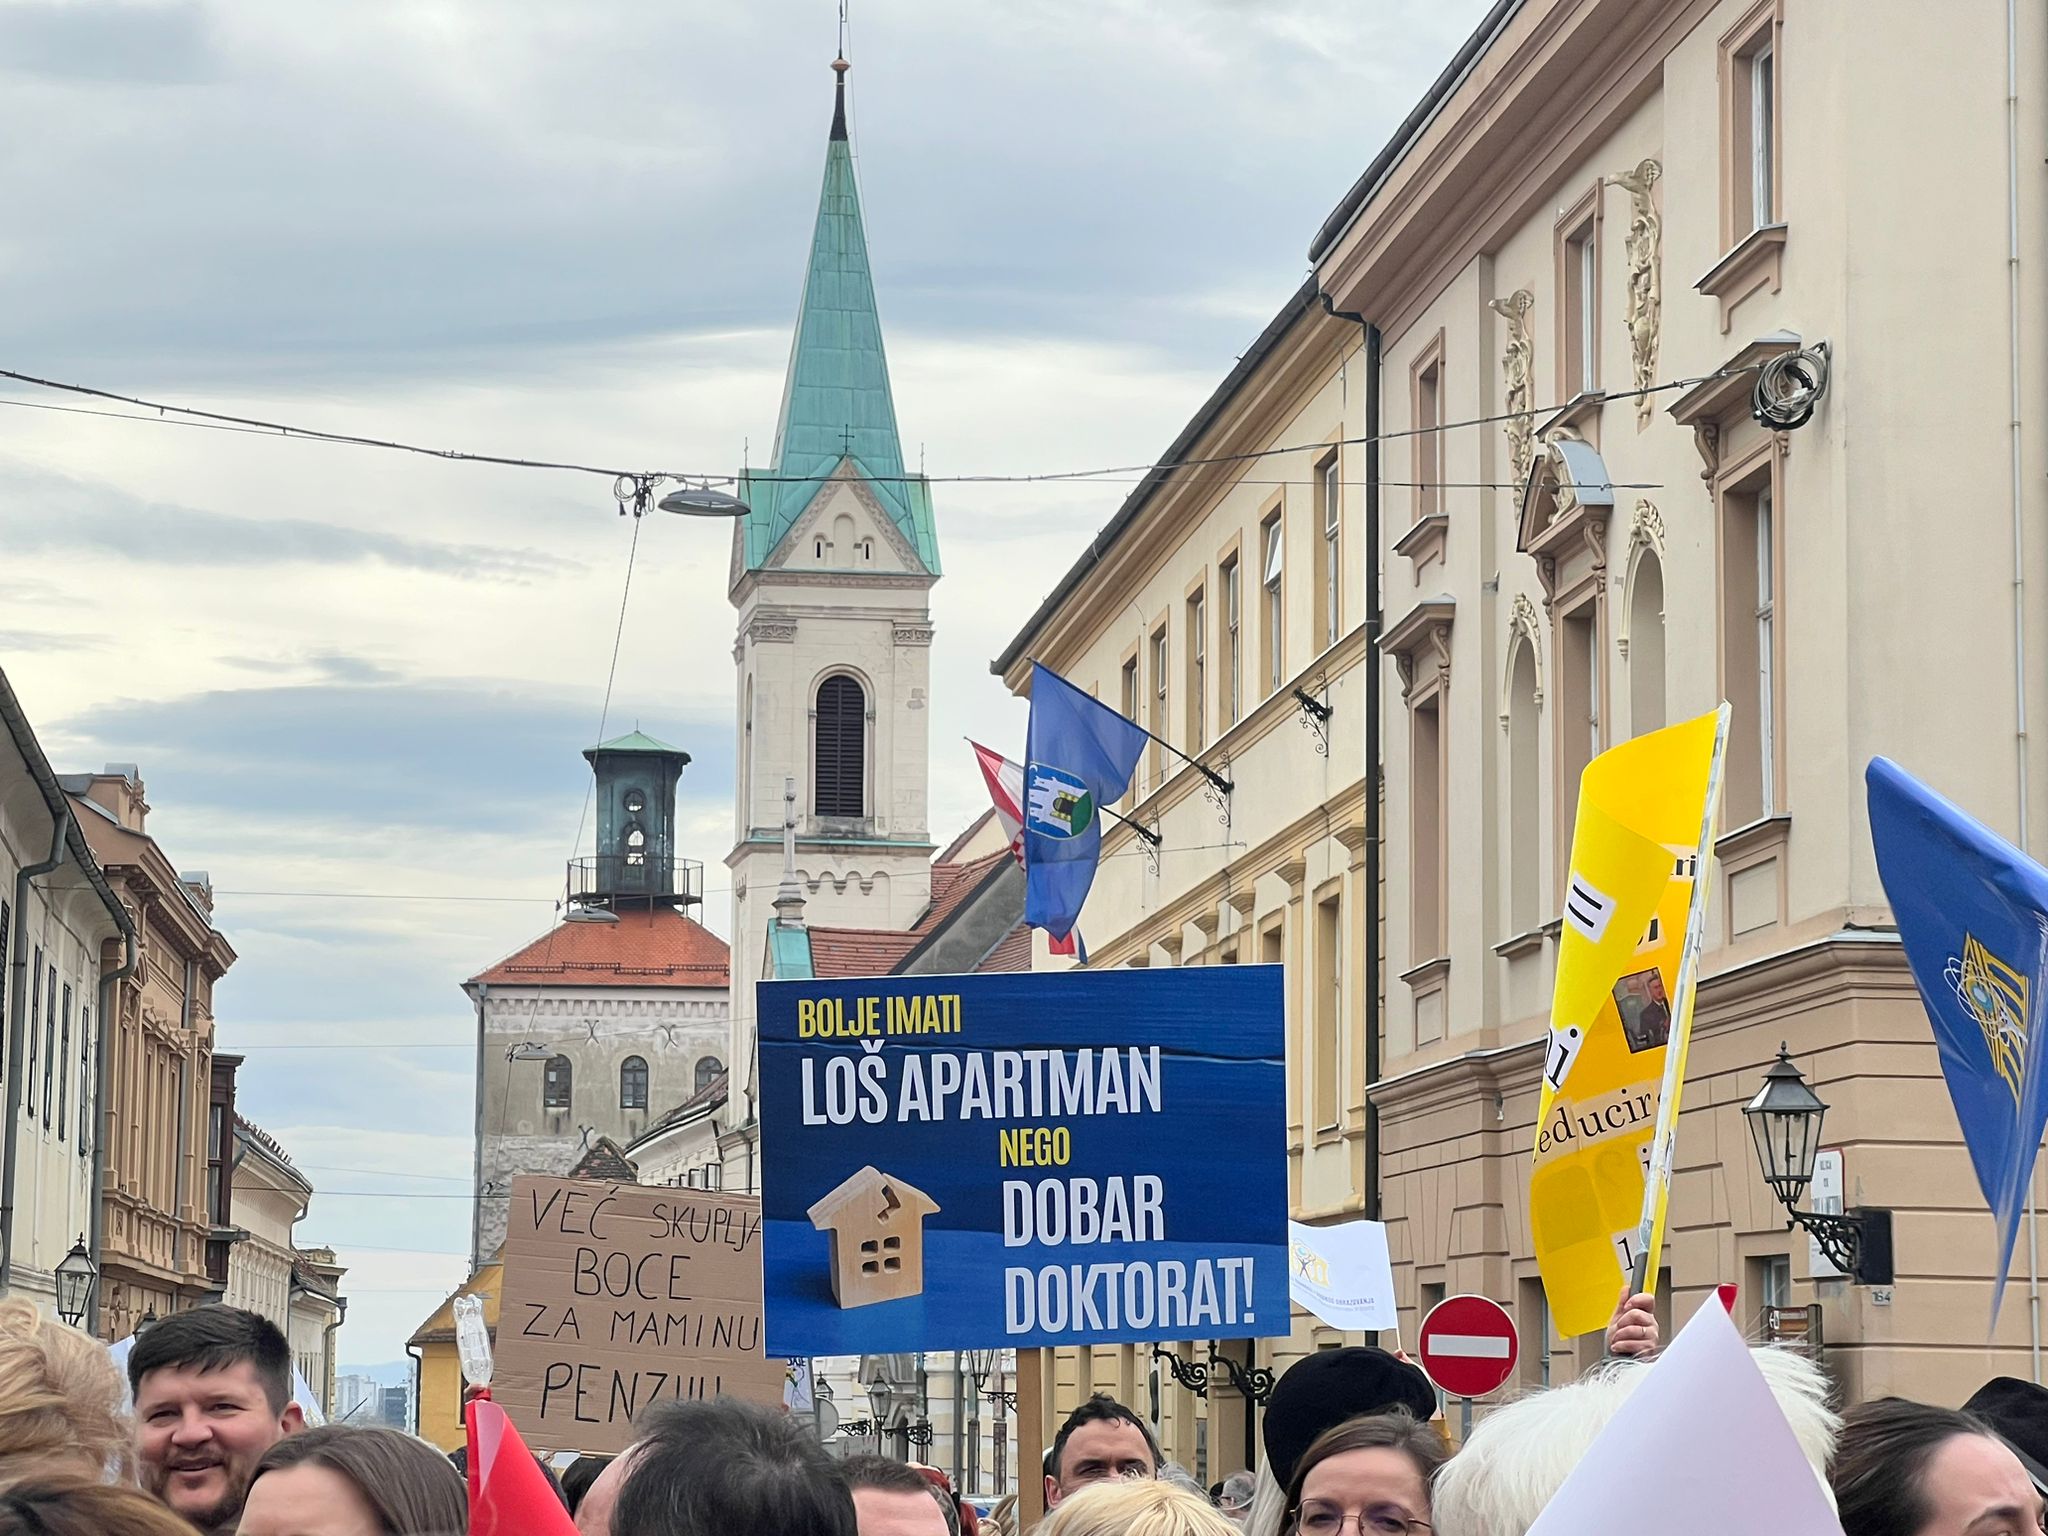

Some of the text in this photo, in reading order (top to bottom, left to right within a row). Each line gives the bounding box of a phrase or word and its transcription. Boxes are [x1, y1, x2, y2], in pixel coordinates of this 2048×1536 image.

[798, 994, 961, 1038] BOLJE IMATI
[801, 1039, 1162, 1125] LOŠ APARTMAN
[999, 1126, 1071, 1168] NEGO
[532, 1186, 619, 1240] VEĆ
[1002, 1174, 1165, 1248] DOBAR
[574, 1247, 692, 1301] BOCE
[1004, 1256, 1256, 1335] DOKTORAT!
[522, 1303, 759, 1351] ZA MAMINU
